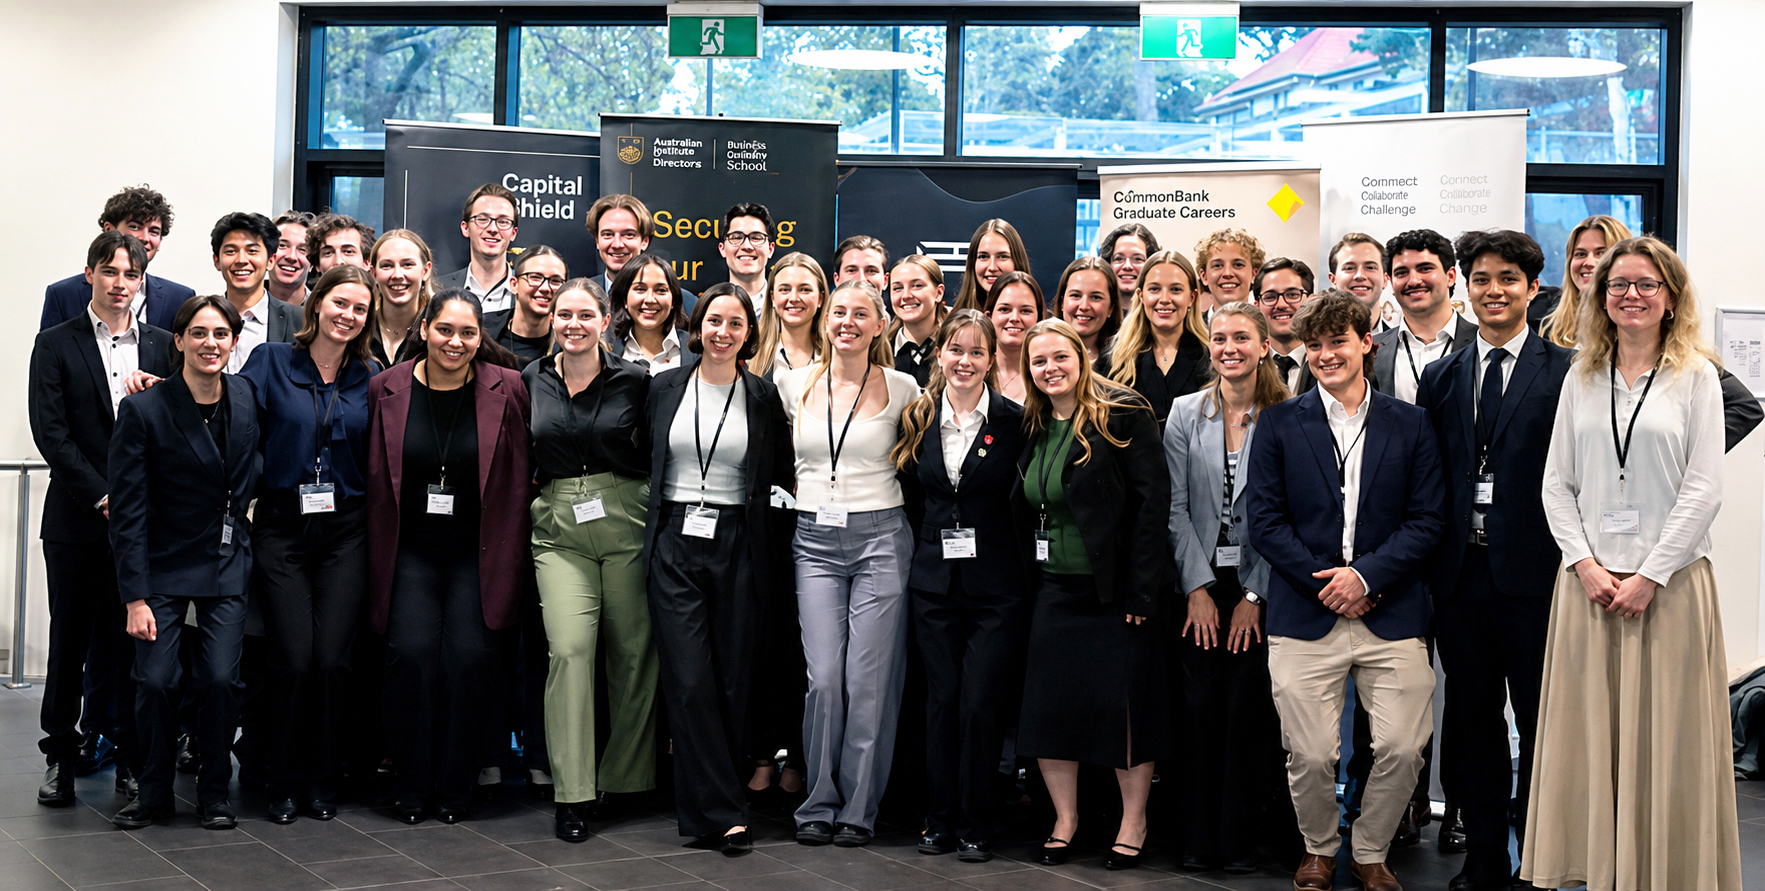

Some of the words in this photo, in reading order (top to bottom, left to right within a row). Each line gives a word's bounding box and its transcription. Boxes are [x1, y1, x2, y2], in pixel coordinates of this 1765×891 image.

[653, 158, 702, 168] Directors
[727, 160, 767, 171] School
[502, 173, 582, 198] Capital
[1440, 174, 1488, 185] Connect
[1113, 206, 1176, 219] Graduate
[1180, 206, 1236, 218] Careers
[1360, 204, 1417, 217] Challenge
[1439, 202, 1488, 216] Change
